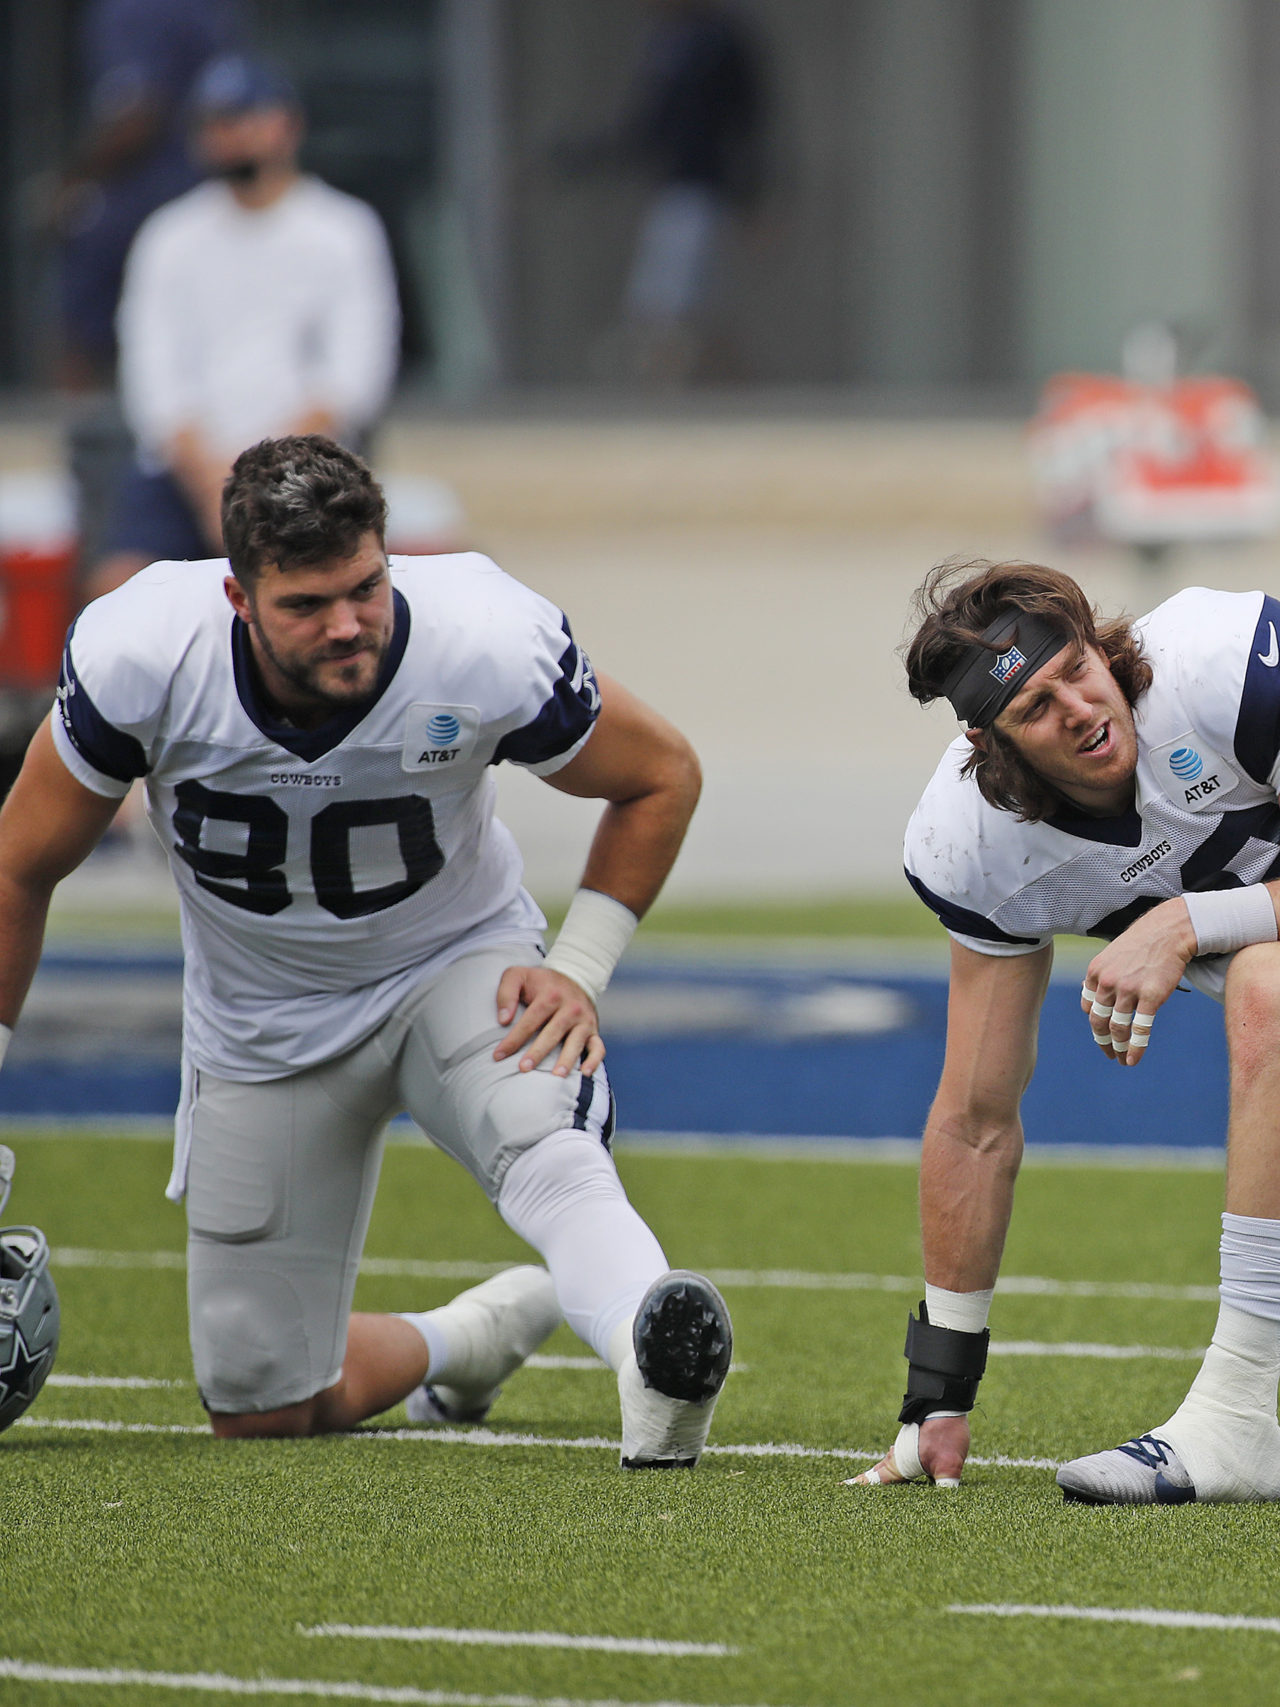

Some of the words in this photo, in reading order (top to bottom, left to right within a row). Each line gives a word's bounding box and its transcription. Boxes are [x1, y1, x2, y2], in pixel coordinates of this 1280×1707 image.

[418, 749, 461, 763] AT&T
[271, 774, 342, 786] COWBOYS
[1184, 774, 1222, 804] AT&T
[1120, 840, 1172, 883] COWBOYS
